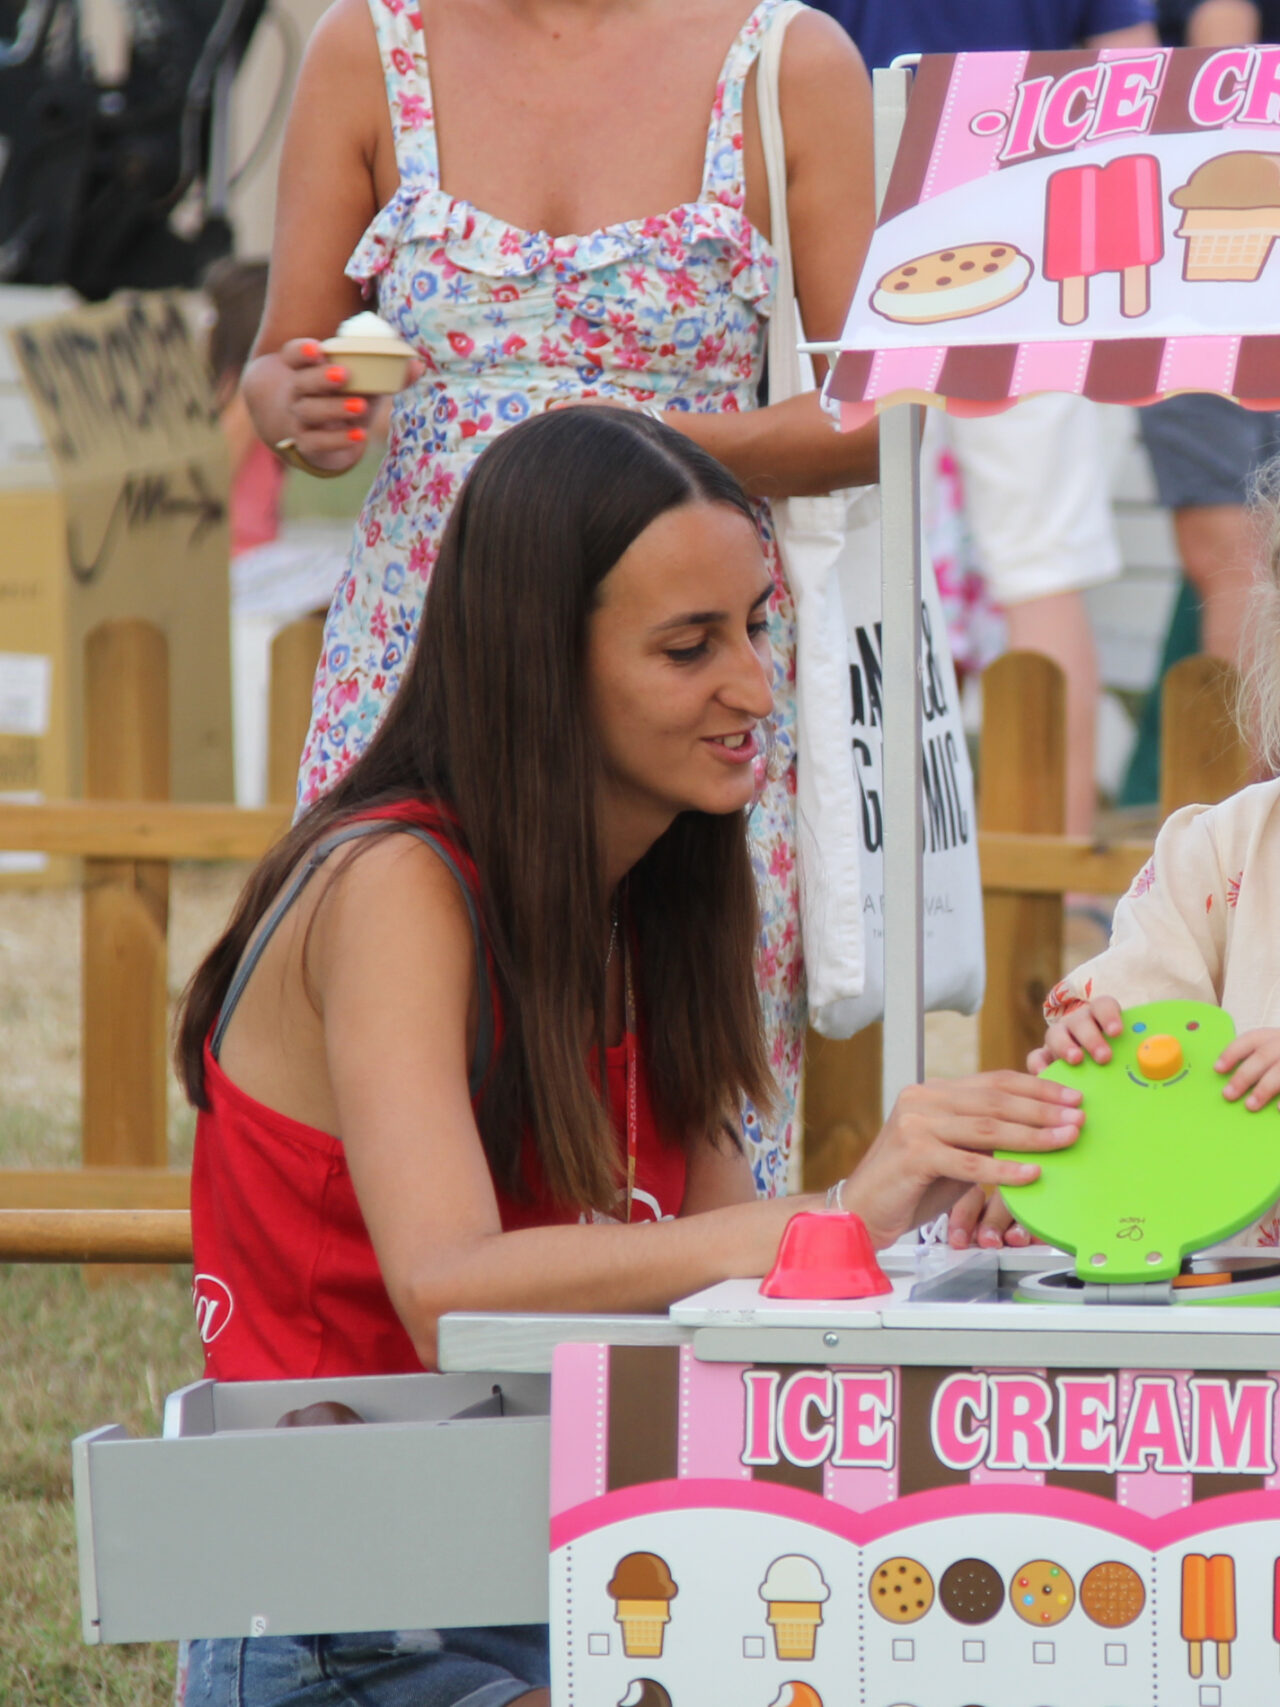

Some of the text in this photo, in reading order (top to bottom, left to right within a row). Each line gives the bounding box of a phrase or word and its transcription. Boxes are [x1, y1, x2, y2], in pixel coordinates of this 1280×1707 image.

[1000, 51, 1167, 160] ICE
[741, 1369, 1278, 1475] ICE CREAM
